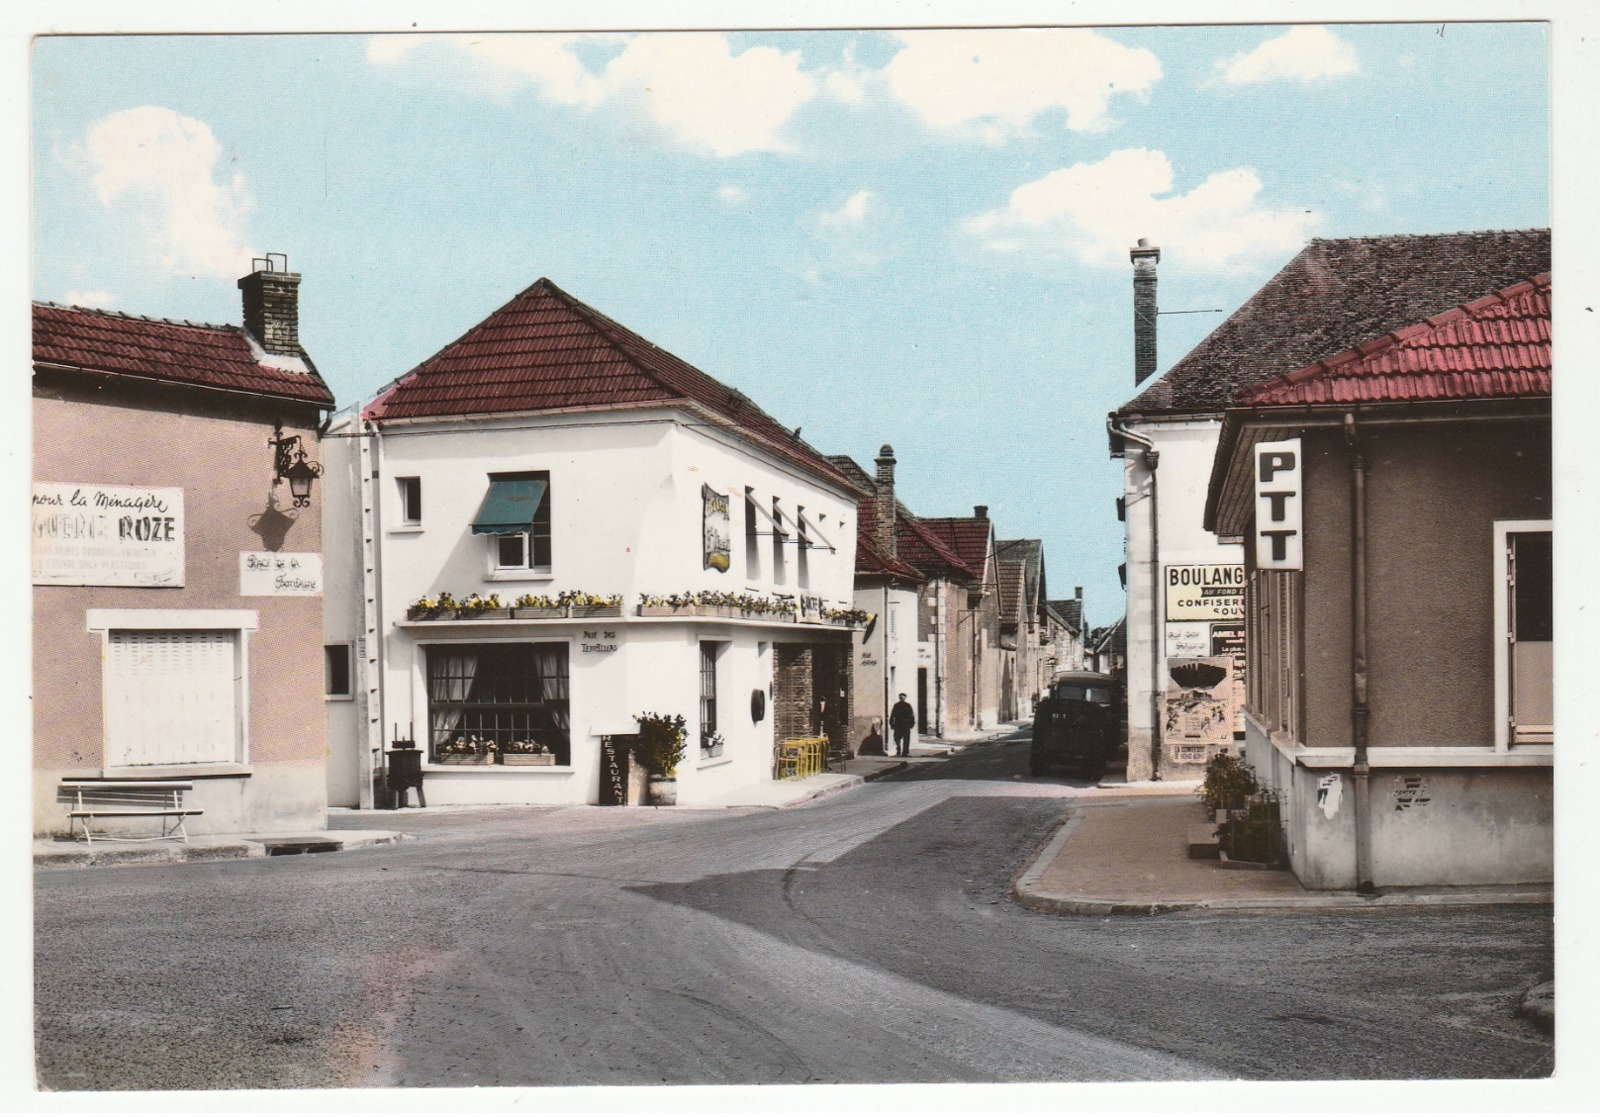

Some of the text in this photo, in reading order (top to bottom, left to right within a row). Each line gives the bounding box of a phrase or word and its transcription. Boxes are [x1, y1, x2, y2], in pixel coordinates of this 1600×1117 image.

[70, 488, 87, 507] la
[1258, 451, 1297, 562] PTT
[118, 515, 175, 542] ROZE
[1170, 568, 1244, 586] BOULANG
[602, 735, 625, 803] RESTAURANT
